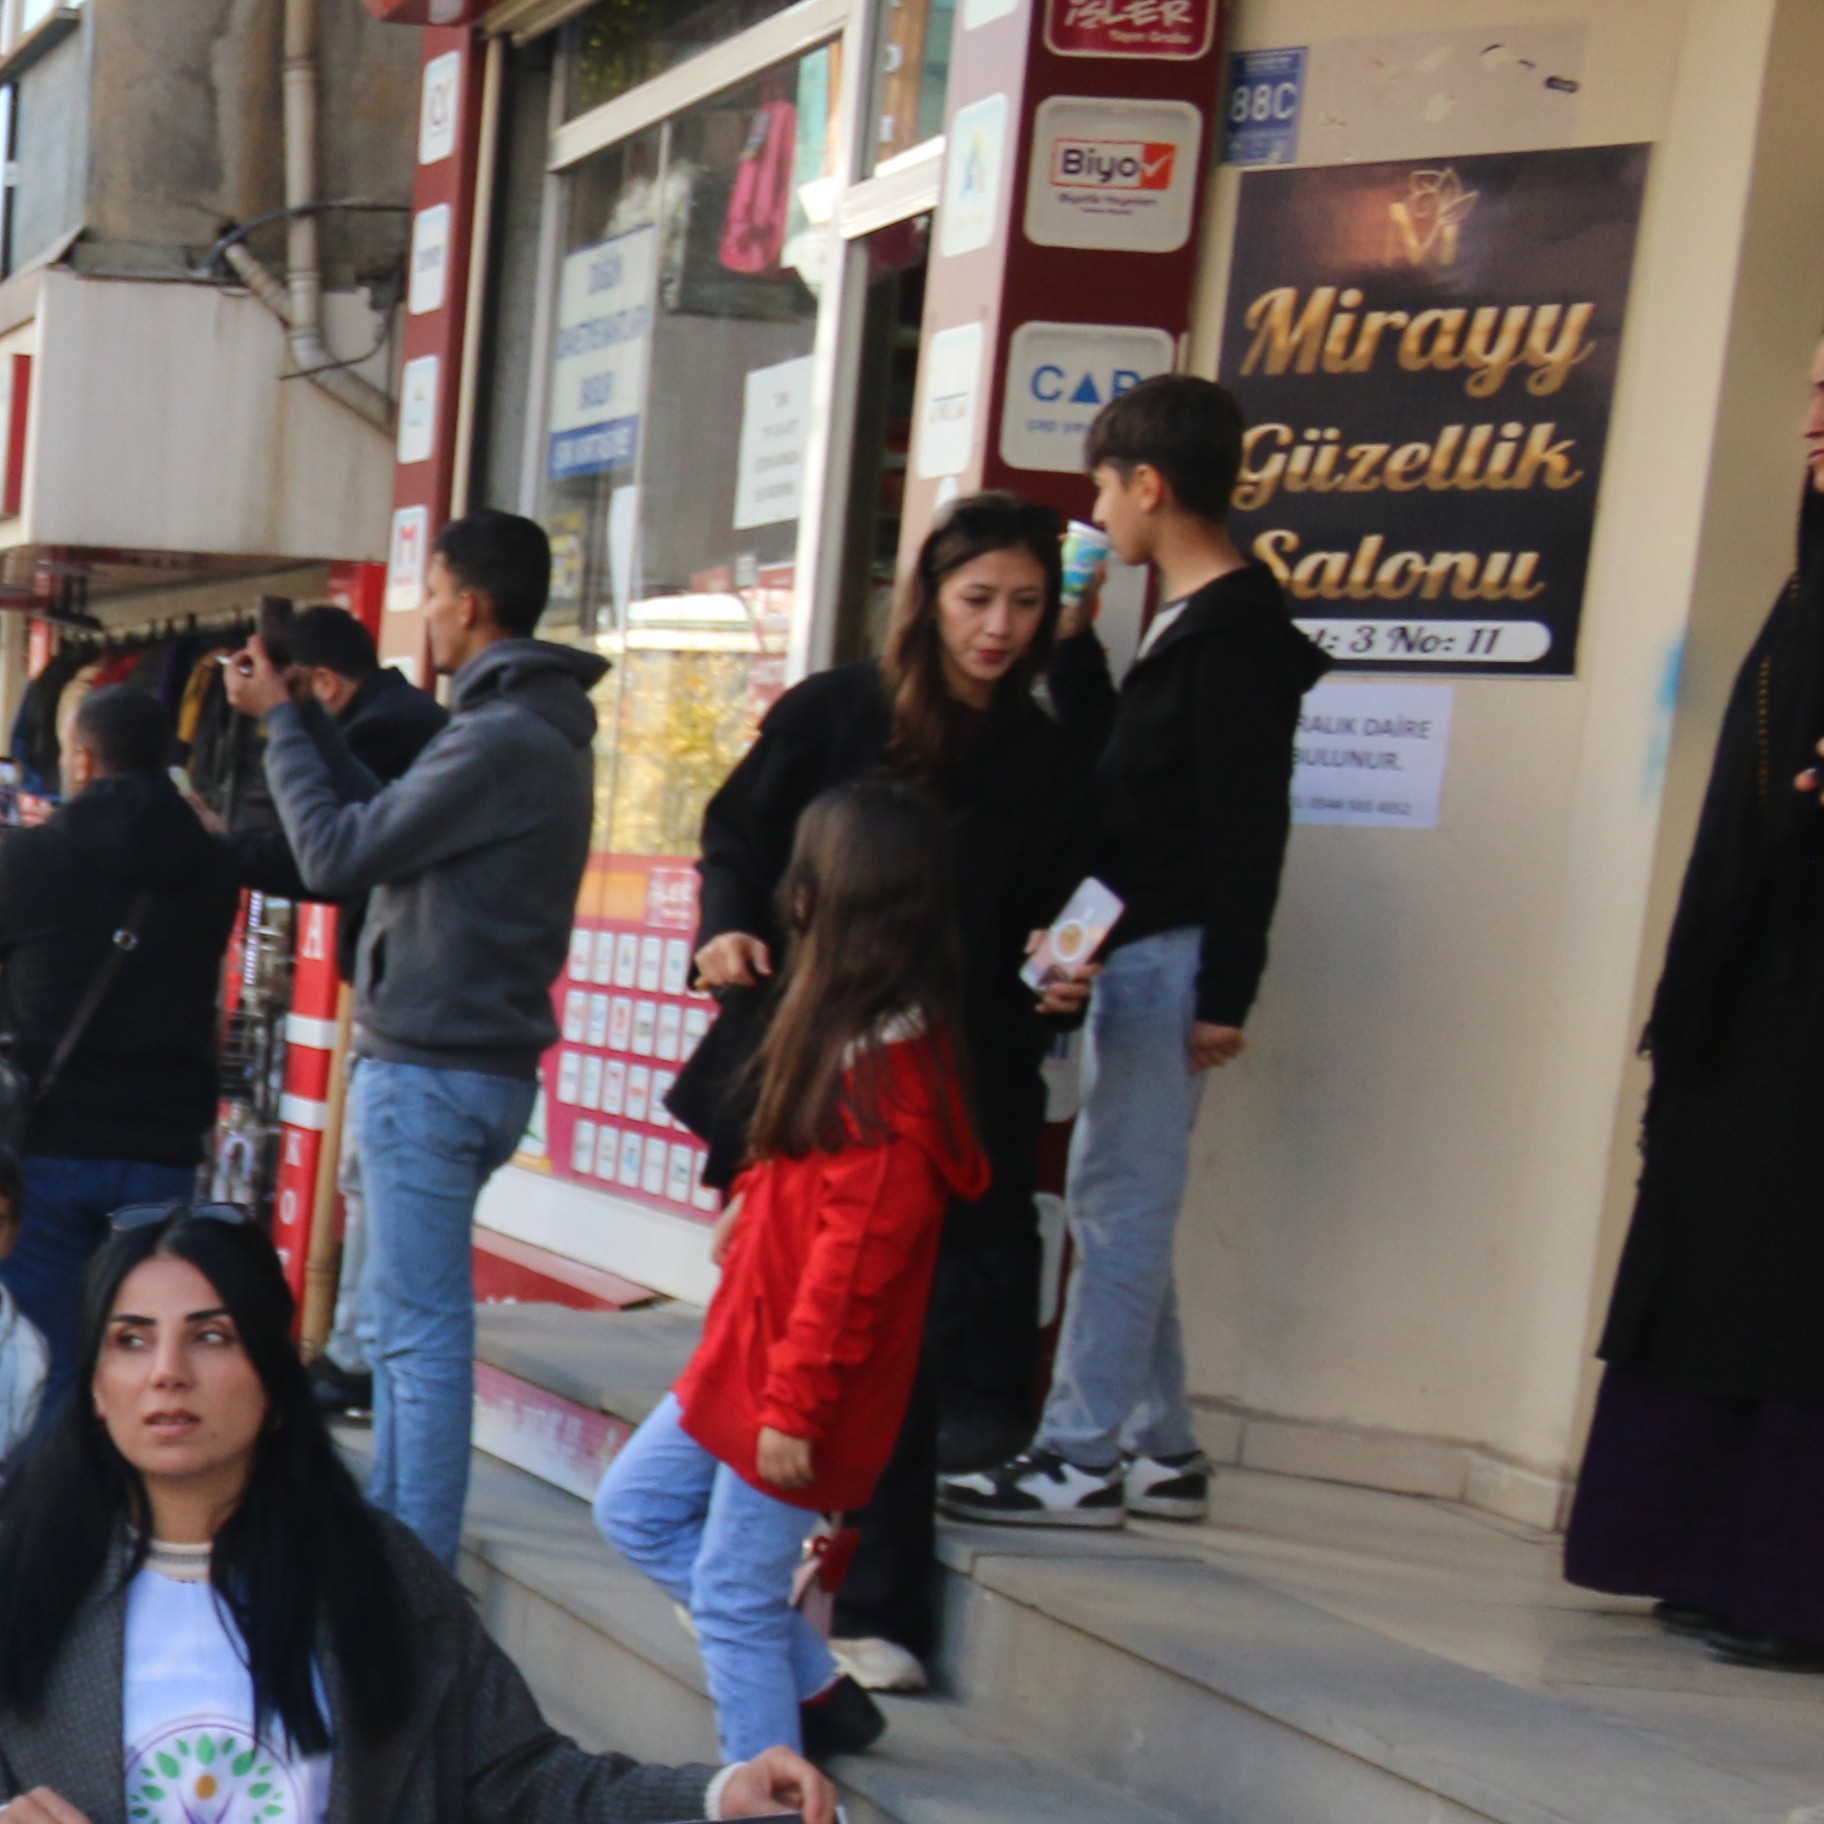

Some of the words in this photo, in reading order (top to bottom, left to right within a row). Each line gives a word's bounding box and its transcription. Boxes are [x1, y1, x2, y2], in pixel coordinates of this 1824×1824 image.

[1230, 82, 1298, 123] 88C
[1061, 148, 1139, 182] Biyo
[1239, 286, 1598, 397] Mirayy
[1230, 421, 1584, 511] Güzellik
[1253, 529, 1546, 600] Salonu
[1350, 625, 1377, 653] 3
[1387, 626, 1455, 654] No:
[1466, 628, 1502, 654] 11
